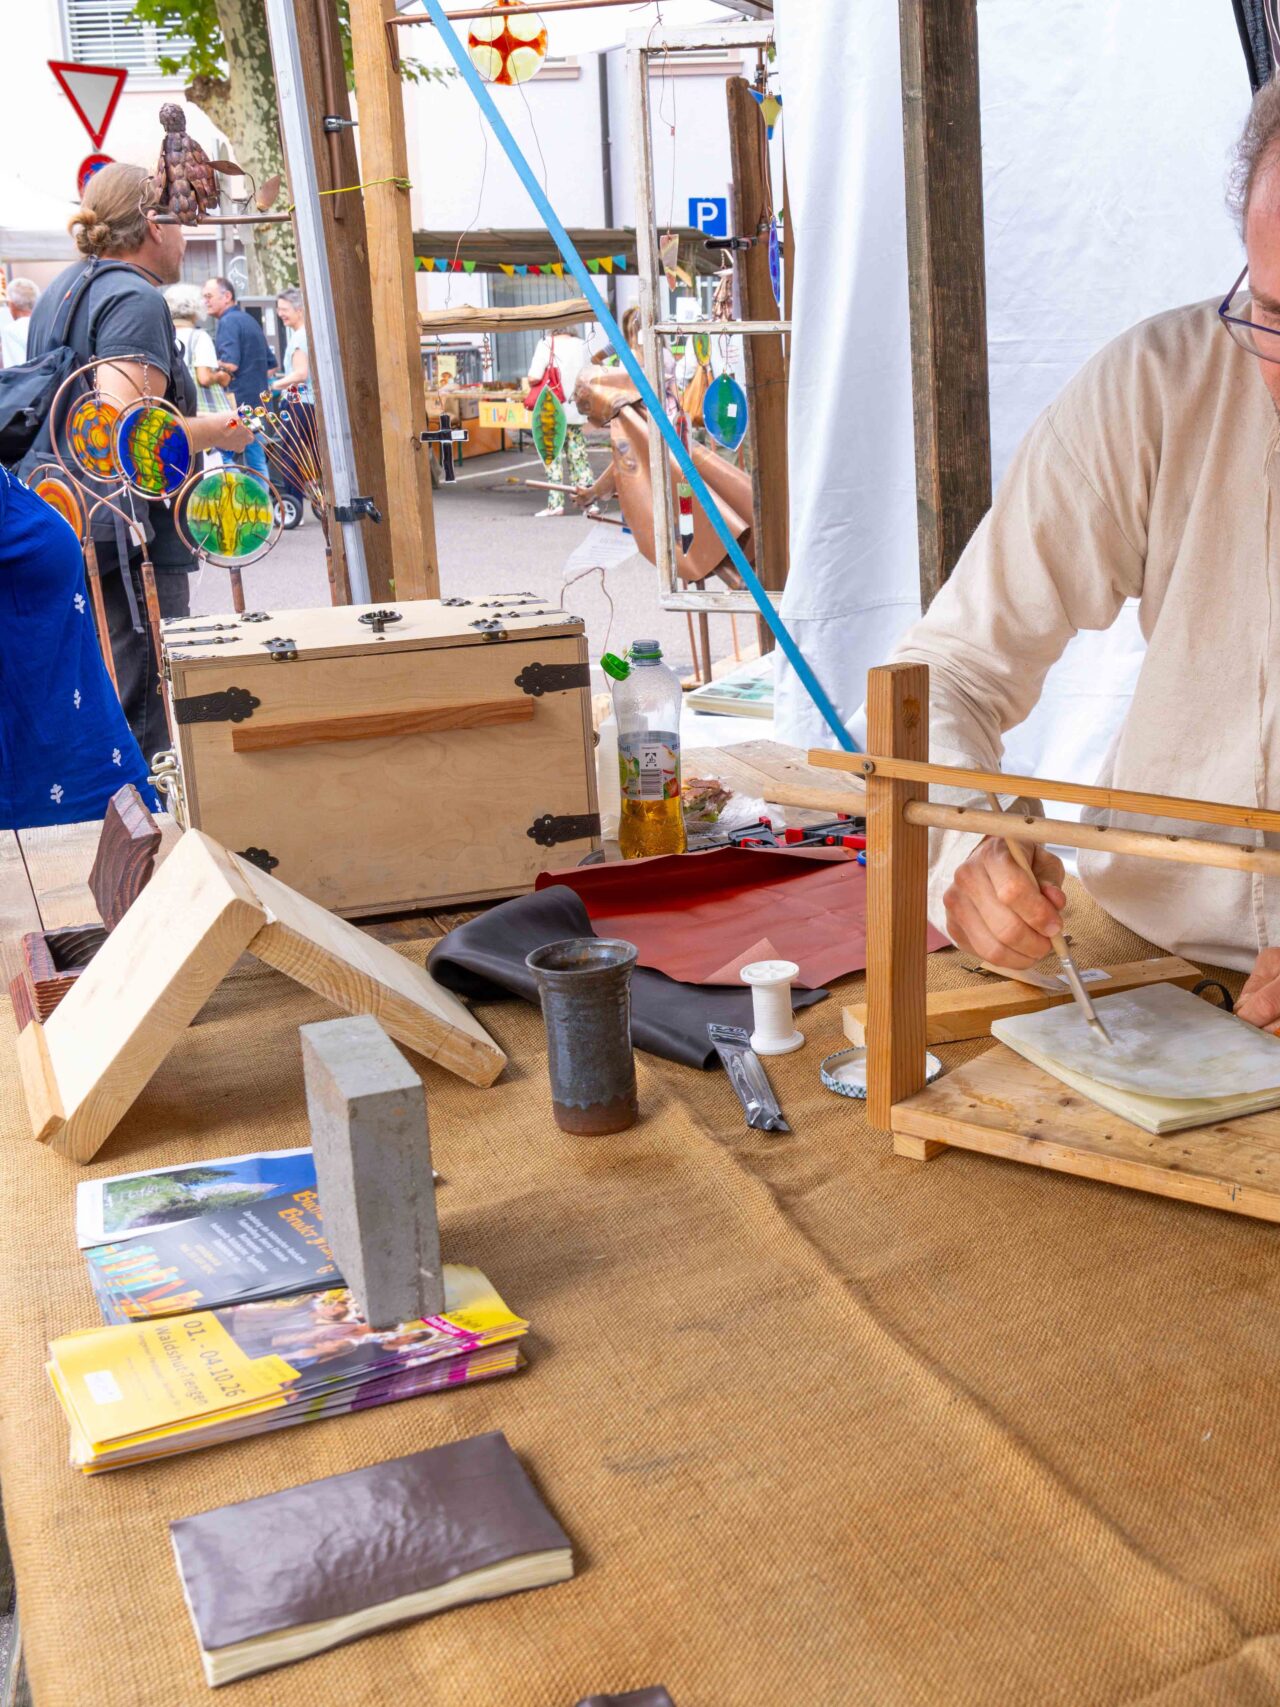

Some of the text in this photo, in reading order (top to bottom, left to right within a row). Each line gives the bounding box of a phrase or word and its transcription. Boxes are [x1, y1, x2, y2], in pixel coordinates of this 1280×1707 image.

[697, 202, 719, 232] P
[183, 1320, 207, 1342] 01.
[199, 1350, 246, 1397] 04.10.26
